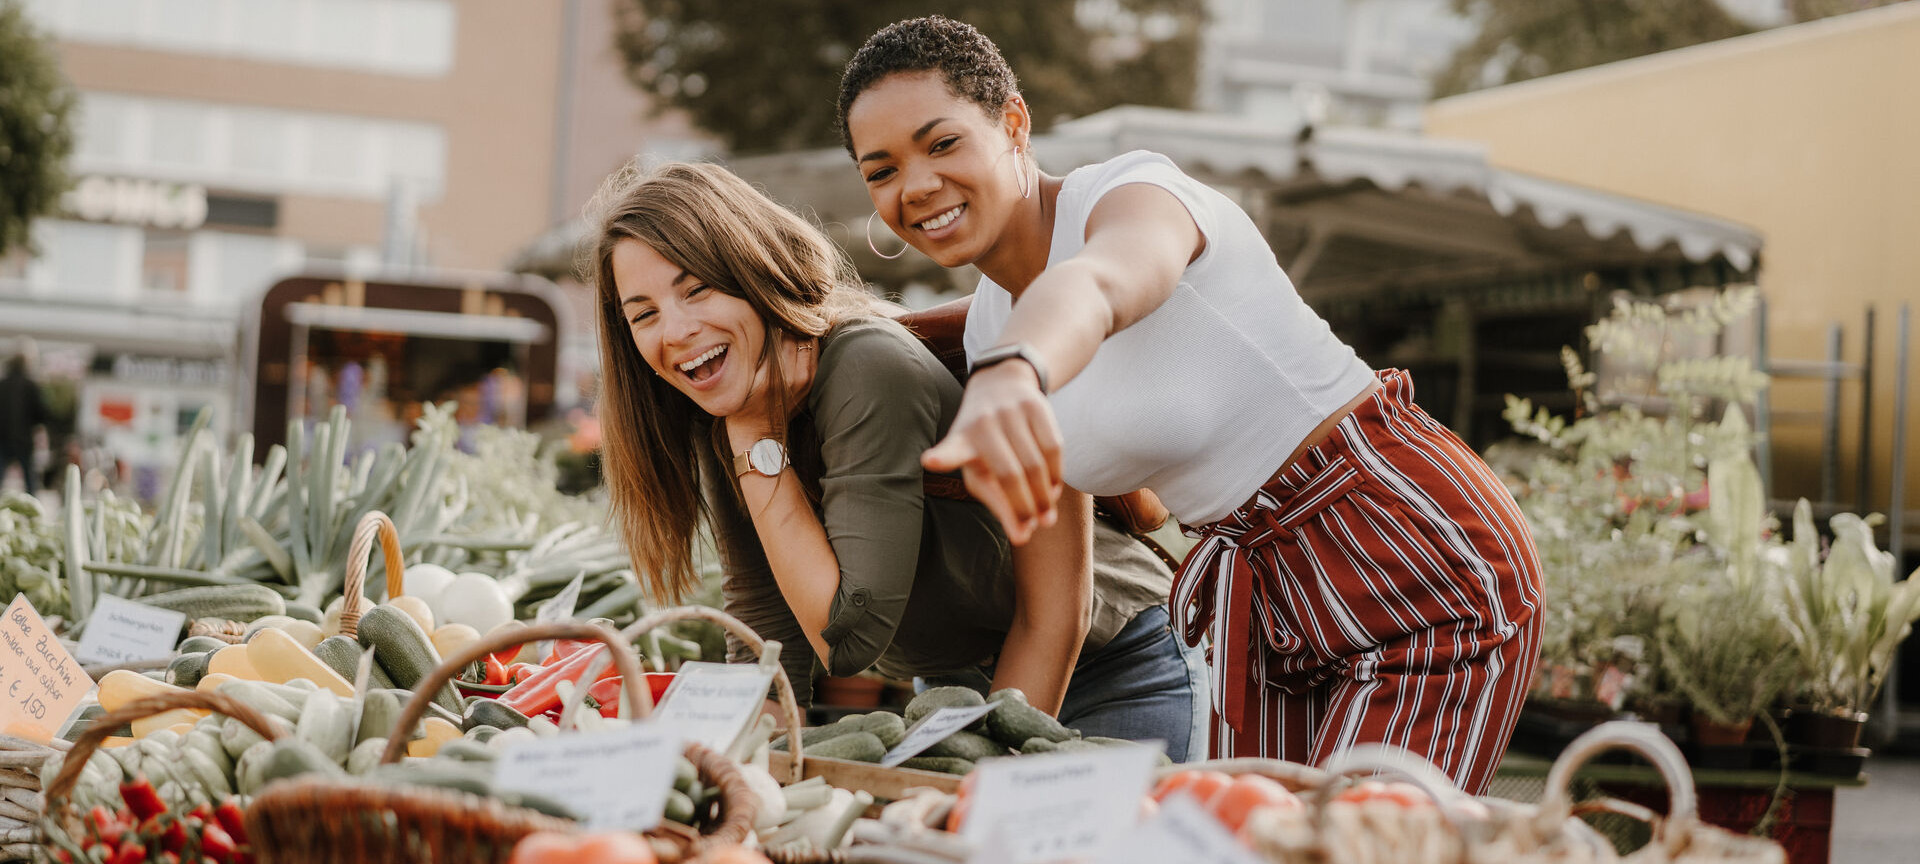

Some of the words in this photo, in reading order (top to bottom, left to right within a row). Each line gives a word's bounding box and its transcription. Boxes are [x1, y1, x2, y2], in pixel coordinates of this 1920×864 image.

[11, 607, 32, 637] Gelbe
[35, 634, 77, 687] Zucchini
[9, 679, 21, 698] €
